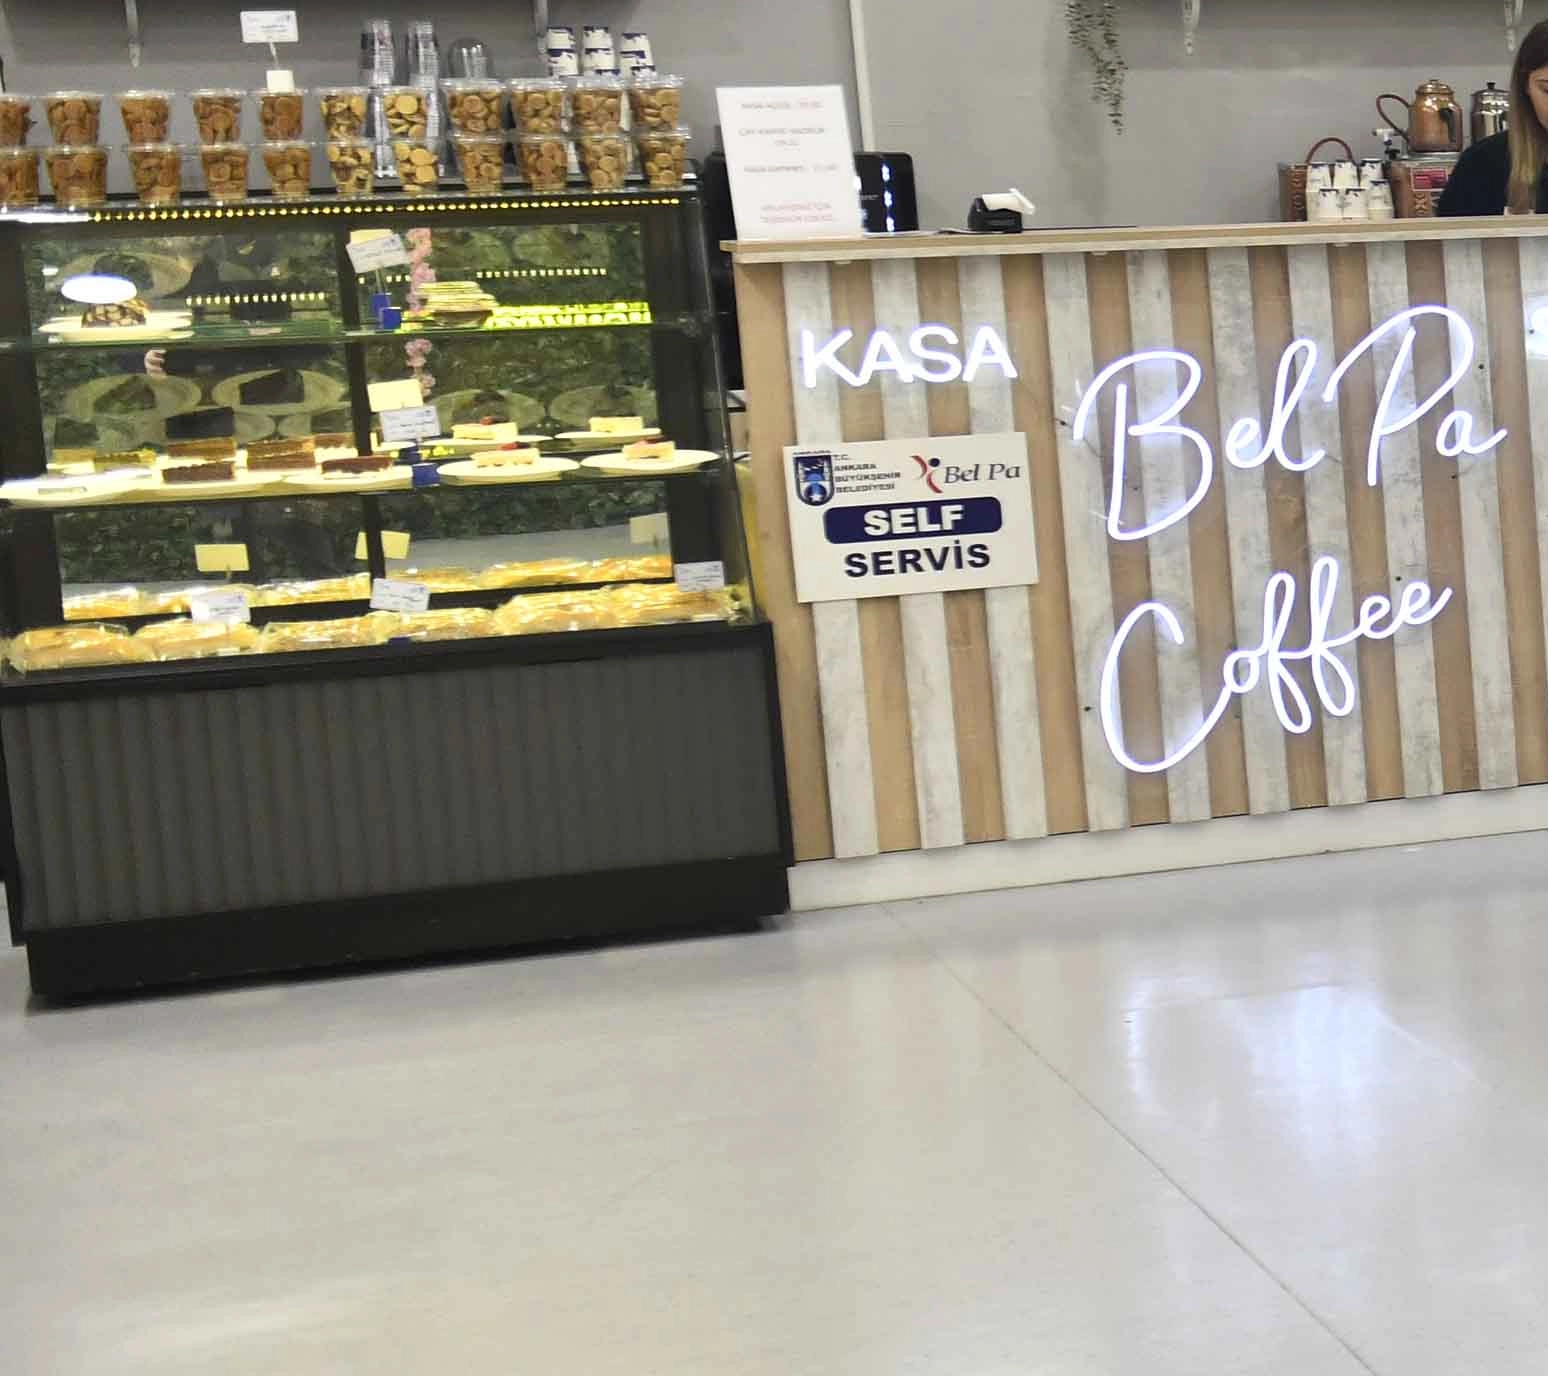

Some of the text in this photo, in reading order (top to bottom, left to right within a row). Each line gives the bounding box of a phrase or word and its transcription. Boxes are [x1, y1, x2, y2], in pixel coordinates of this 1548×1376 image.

[800, 323, 1017, 388] KASA
[1074, 305, 1507, 540] Bel Pa
[835, 463, 876, 471] ANKARA
[945, 464, 1021, 484] Bel Pa
[864, 504, 965, 537] SELF
[845, 539, 991, 578] SERVİS
[1100, 556, 1452, 773] Coffee
